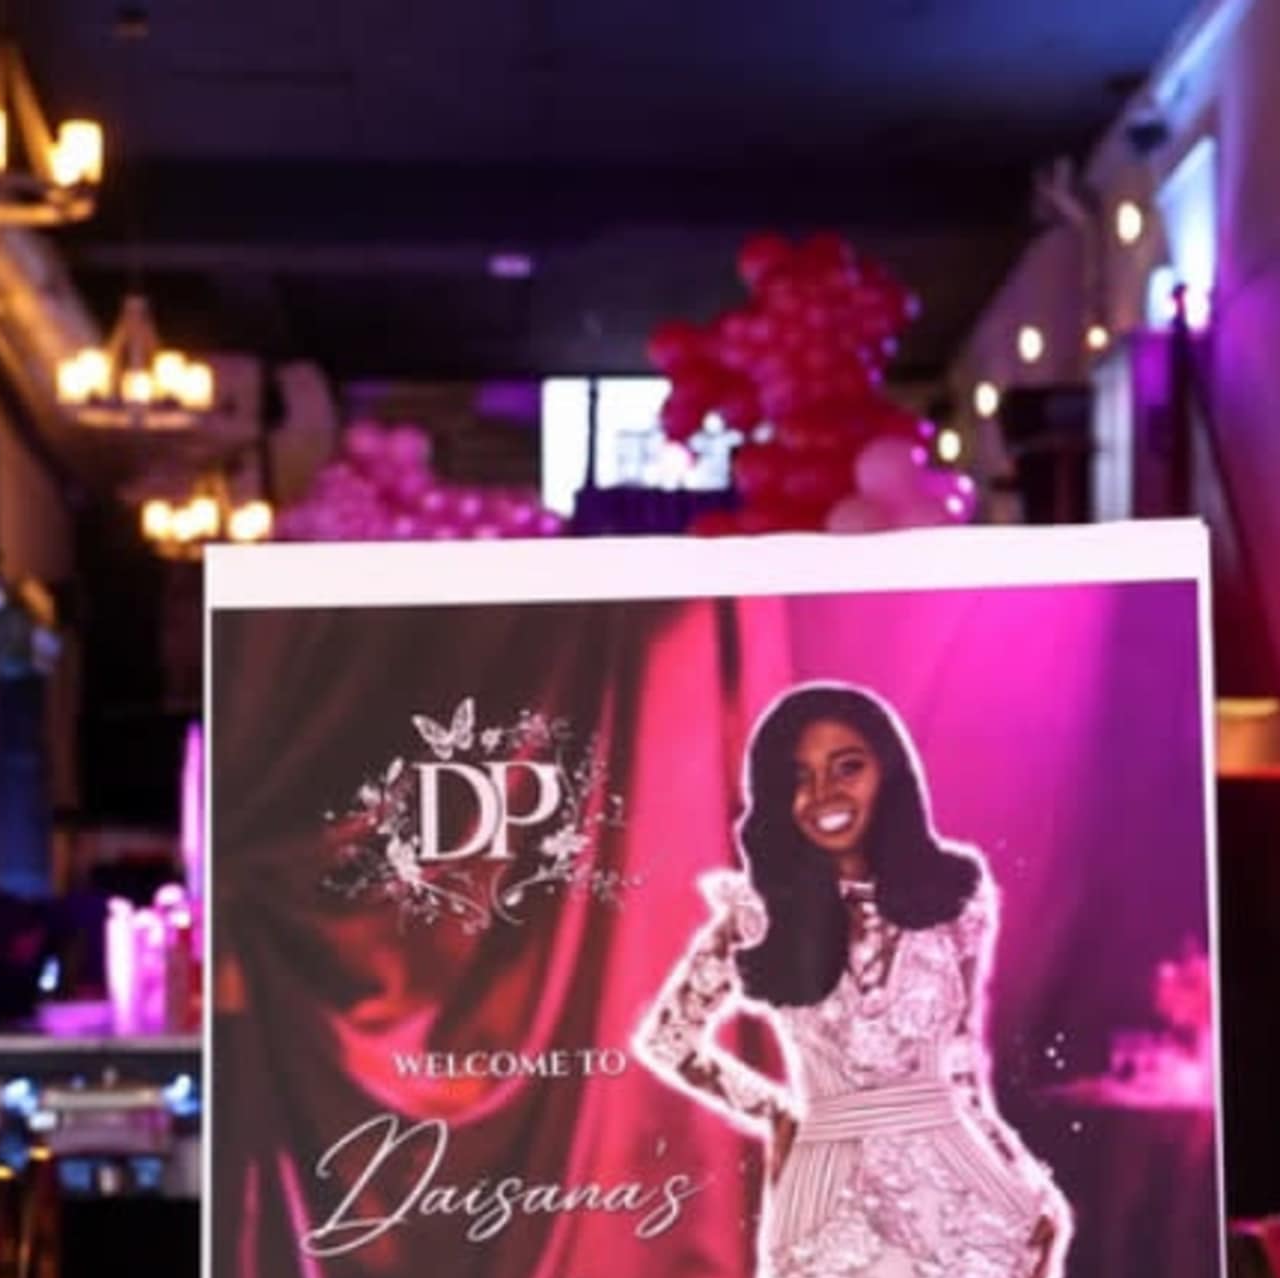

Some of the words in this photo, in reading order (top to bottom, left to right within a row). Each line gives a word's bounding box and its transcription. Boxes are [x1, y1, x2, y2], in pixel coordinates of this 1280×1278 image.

[414, 760, 562, 861] DP
[394, 1051, 569, 1079] WELCOME
[577, 1048, 628, 1076] TO
[302, 1114, 702, 1256] Daisana's
